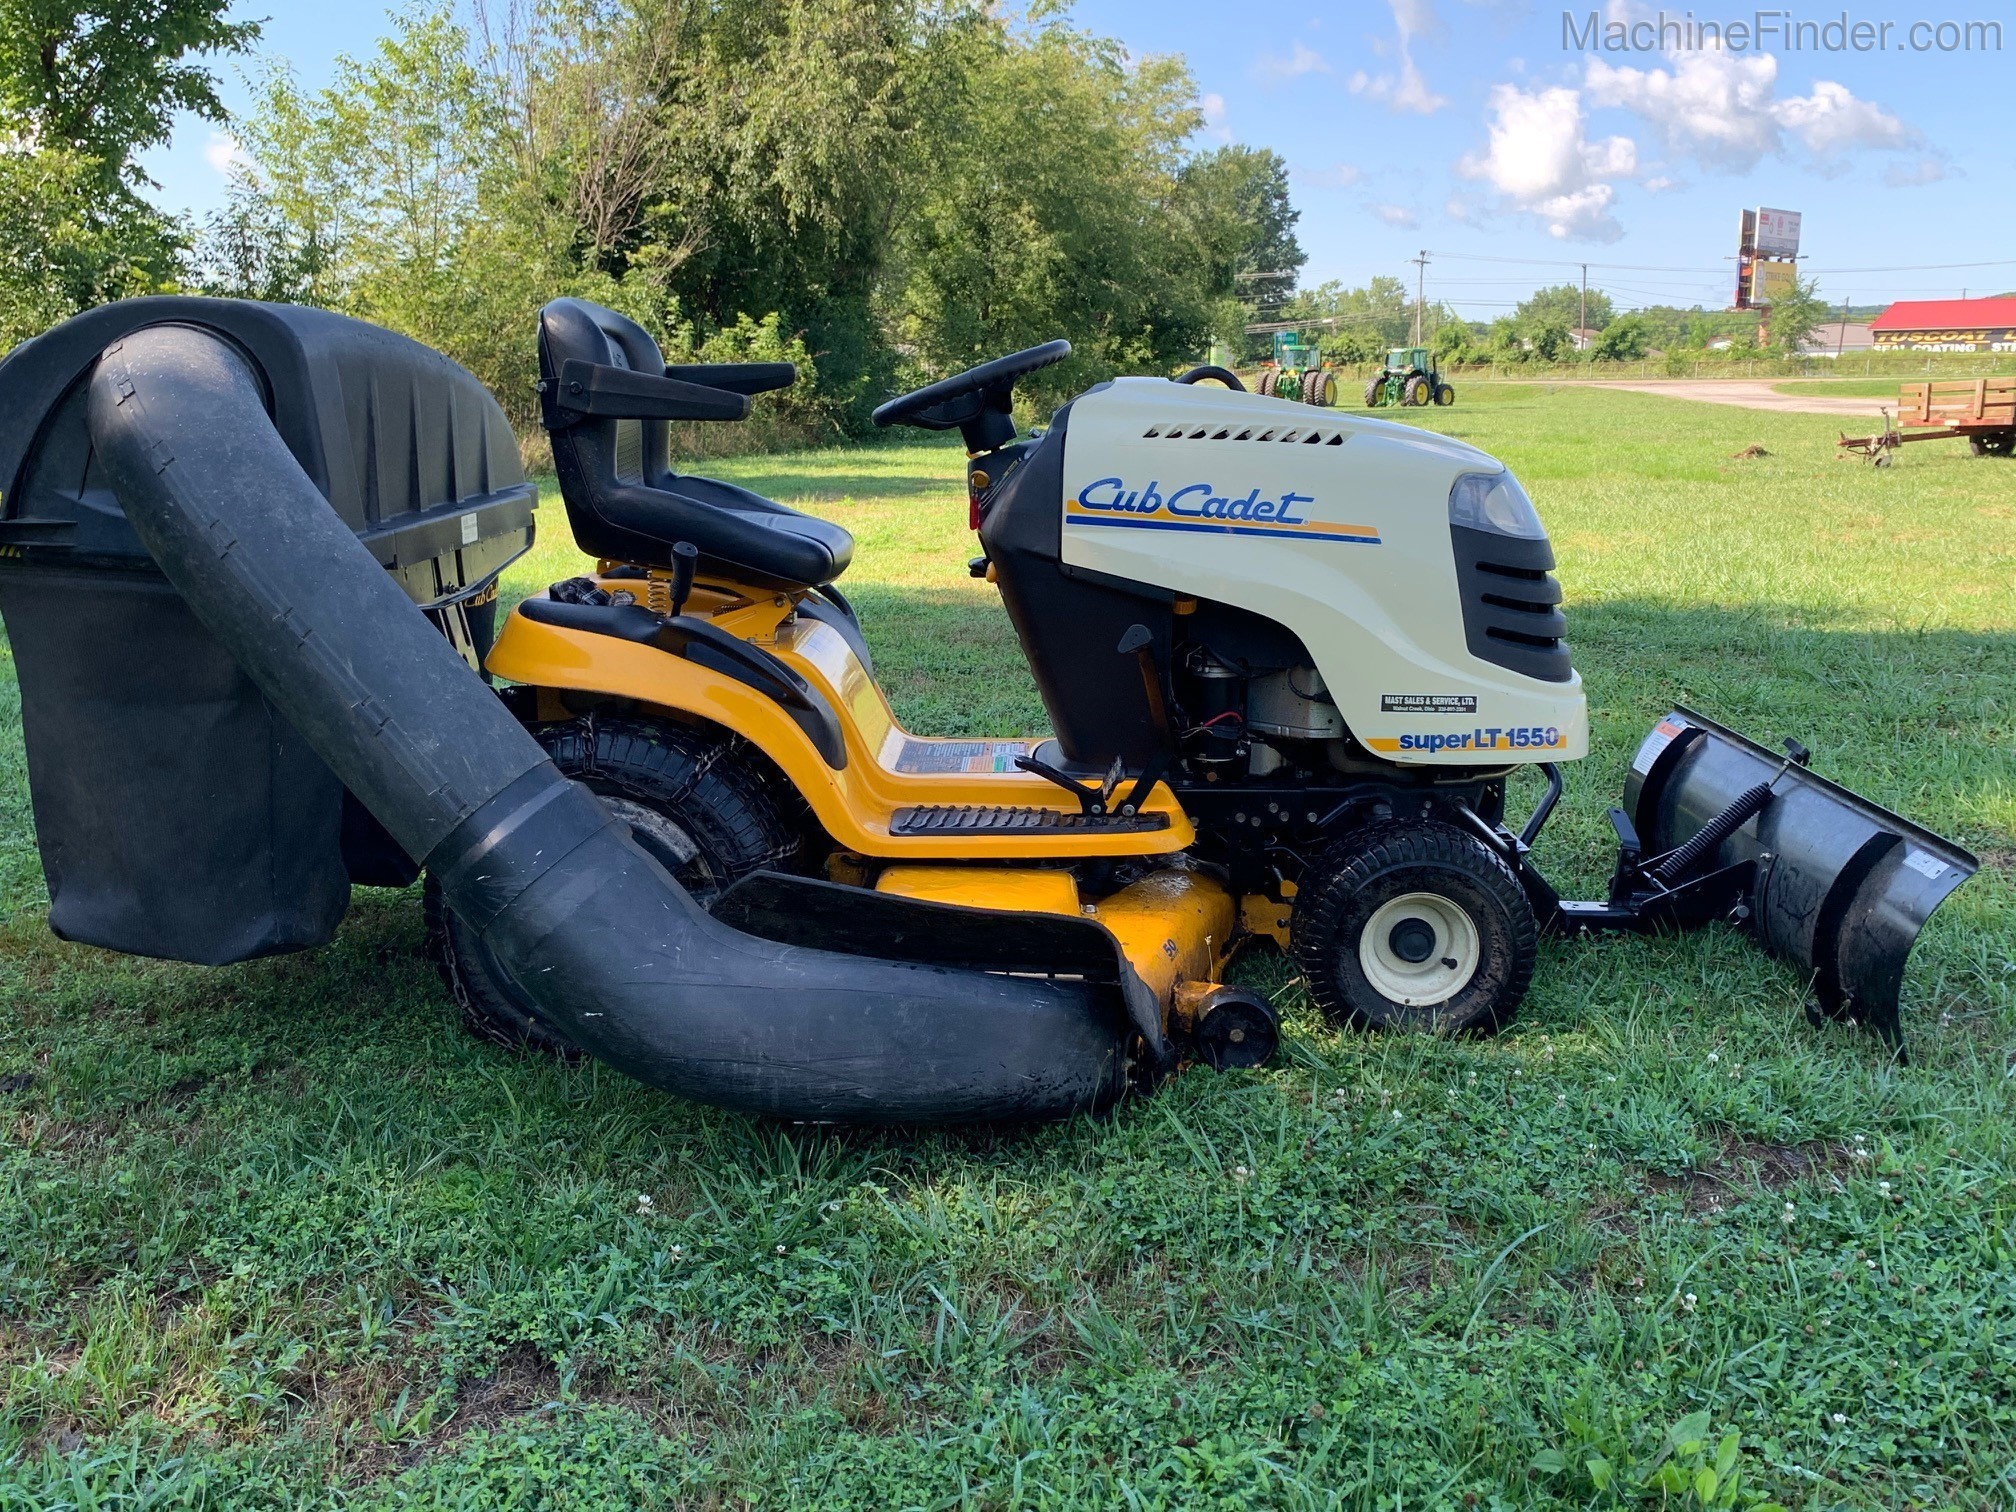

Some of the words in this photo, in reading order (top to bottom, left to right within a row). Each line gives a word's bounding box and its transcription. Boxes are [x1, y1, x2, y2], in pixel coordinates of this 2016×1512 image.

[1877, 331, 1992, 341] TUSCOAT
[1911, 343, 1976, 353] COATING
[1078, 477, 1162, 514] Cub
[1167, 484, 1315, 525] Cadet
[1385, 696, 1403, 705] MAST
[1404, 696, 1424, 705] SALES
[1425, 697, 1431, 705] &
[1432, 697, 1460, 706] SERVICE,
[1461, 697, 1475, 706] LTD.
[1400, 733, 1471, 753] super
[1474, 729, 1502, 748] LT
[1506, 727, 1559, 747] 1550
[1163, 938, 1176, 957] 50
